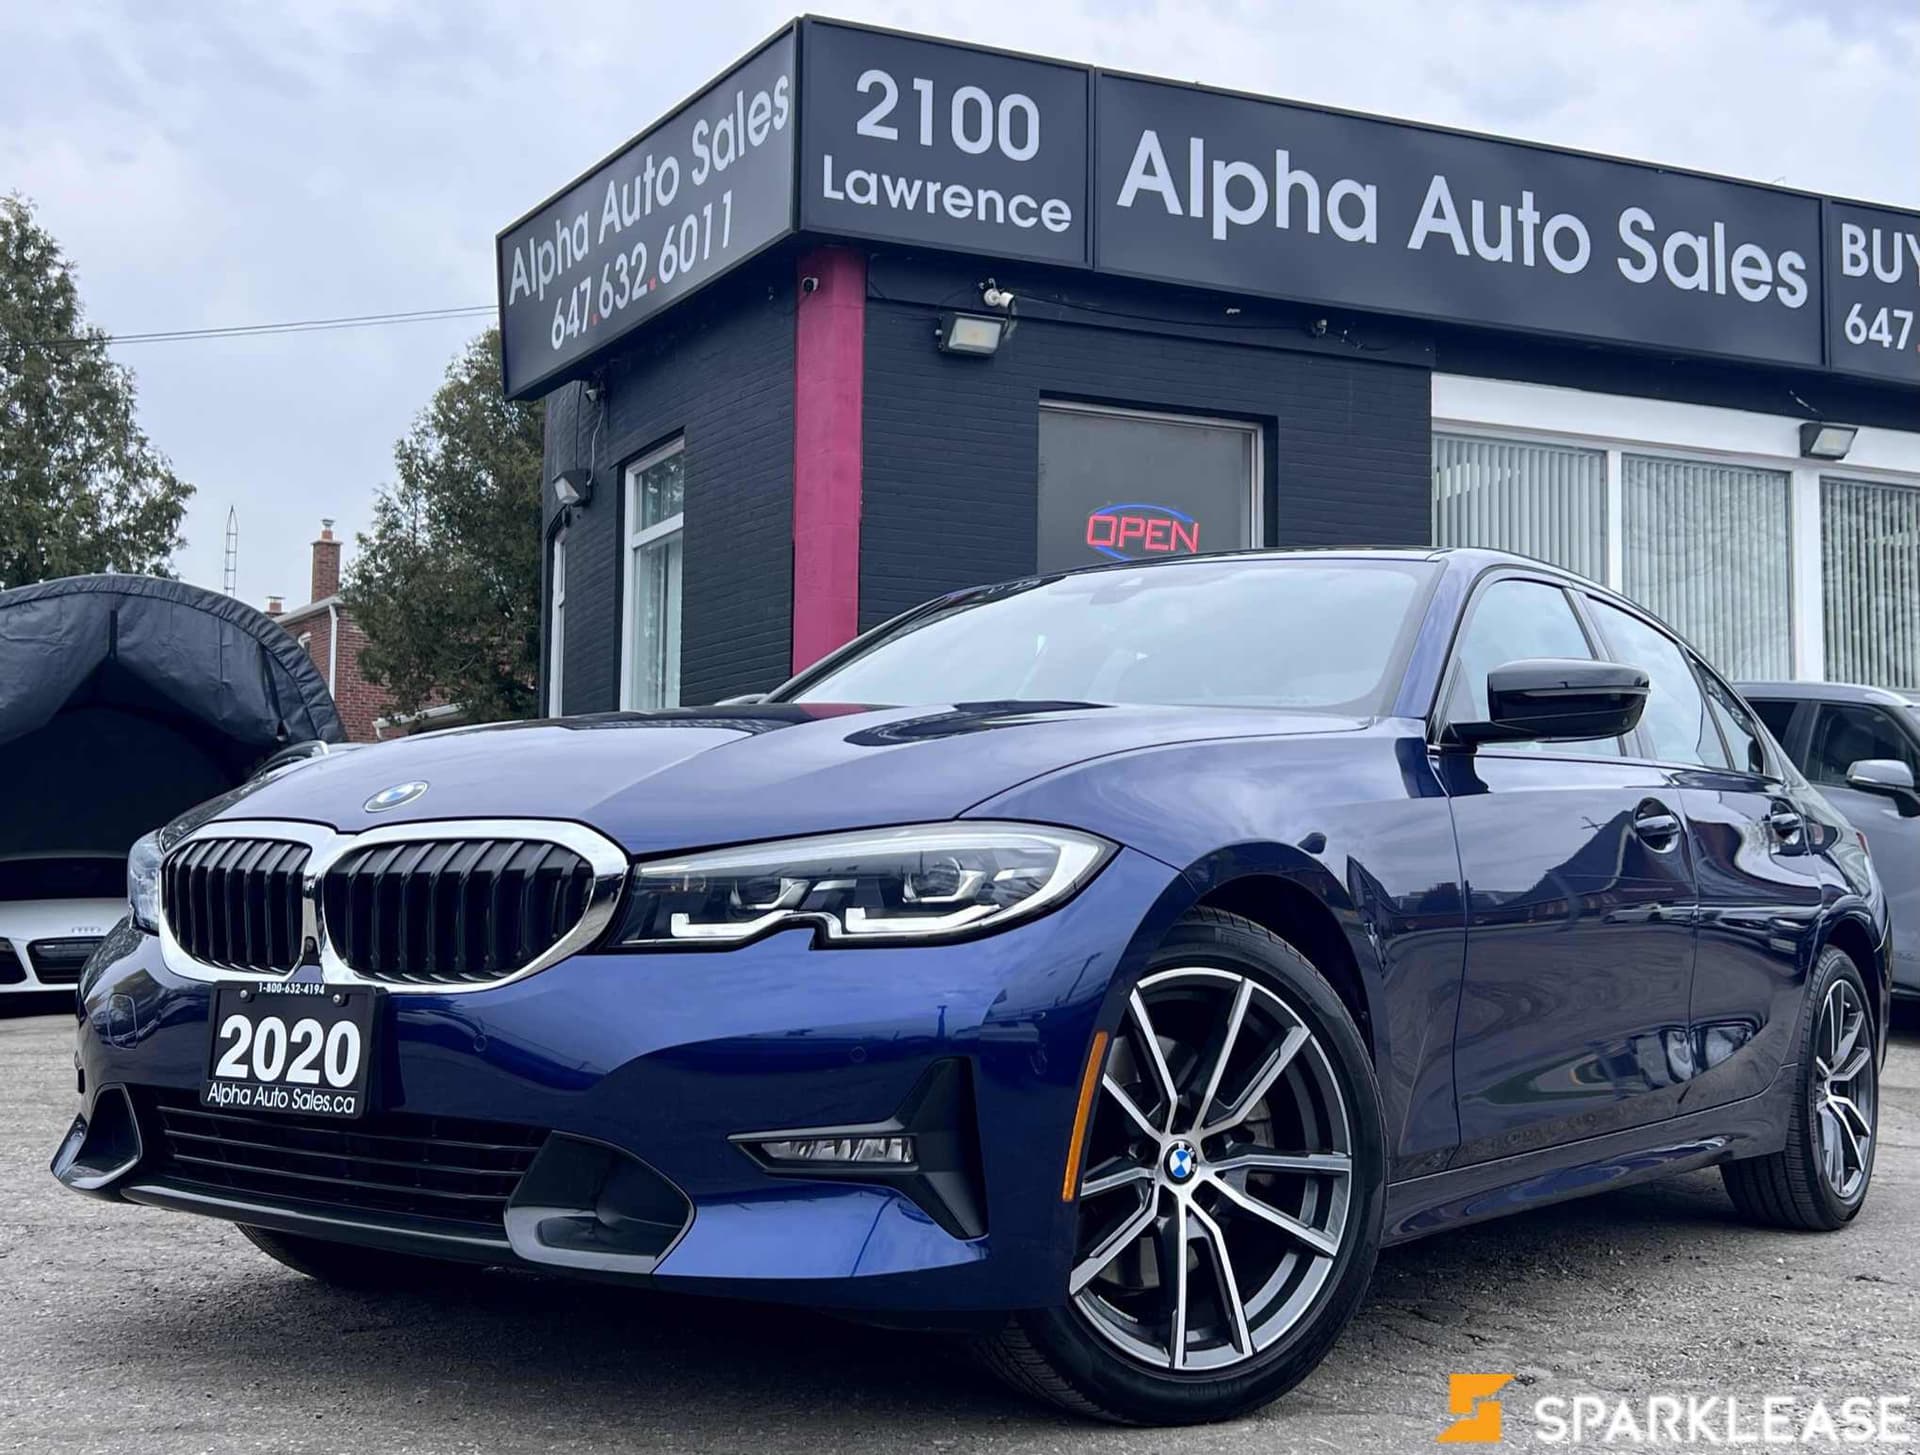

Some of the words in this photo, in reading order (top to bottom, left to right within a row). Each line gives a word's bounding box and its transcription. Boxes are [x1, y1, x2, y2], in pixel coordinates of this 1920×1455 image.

[856, 69, 1040, 162] 2100
[509, 210, 589, 306] Alpha
[599, 154, 680, 244] Auto
[692, 75, 789, 186] Sales
[822, 154, 1073, 233] Lawrence
[1117, 129, 1378, 244] Alpha
[1407, 175, 1592, 275] Auto
[1616, 207, 1809, 310] Sales
[551, 190, 732, 350] 647.632.6011
[1087, 514, 1200, 554] OPEN
[258, 982, 325, 995] 1-800-632-4194
[215, 1014, 361, 1088] 2020
[207, 1082, 251, 1107] Alpha
[253, 1086, 289, 1109] Auto
[291, 1089, 356, 1113] Sales.ca
